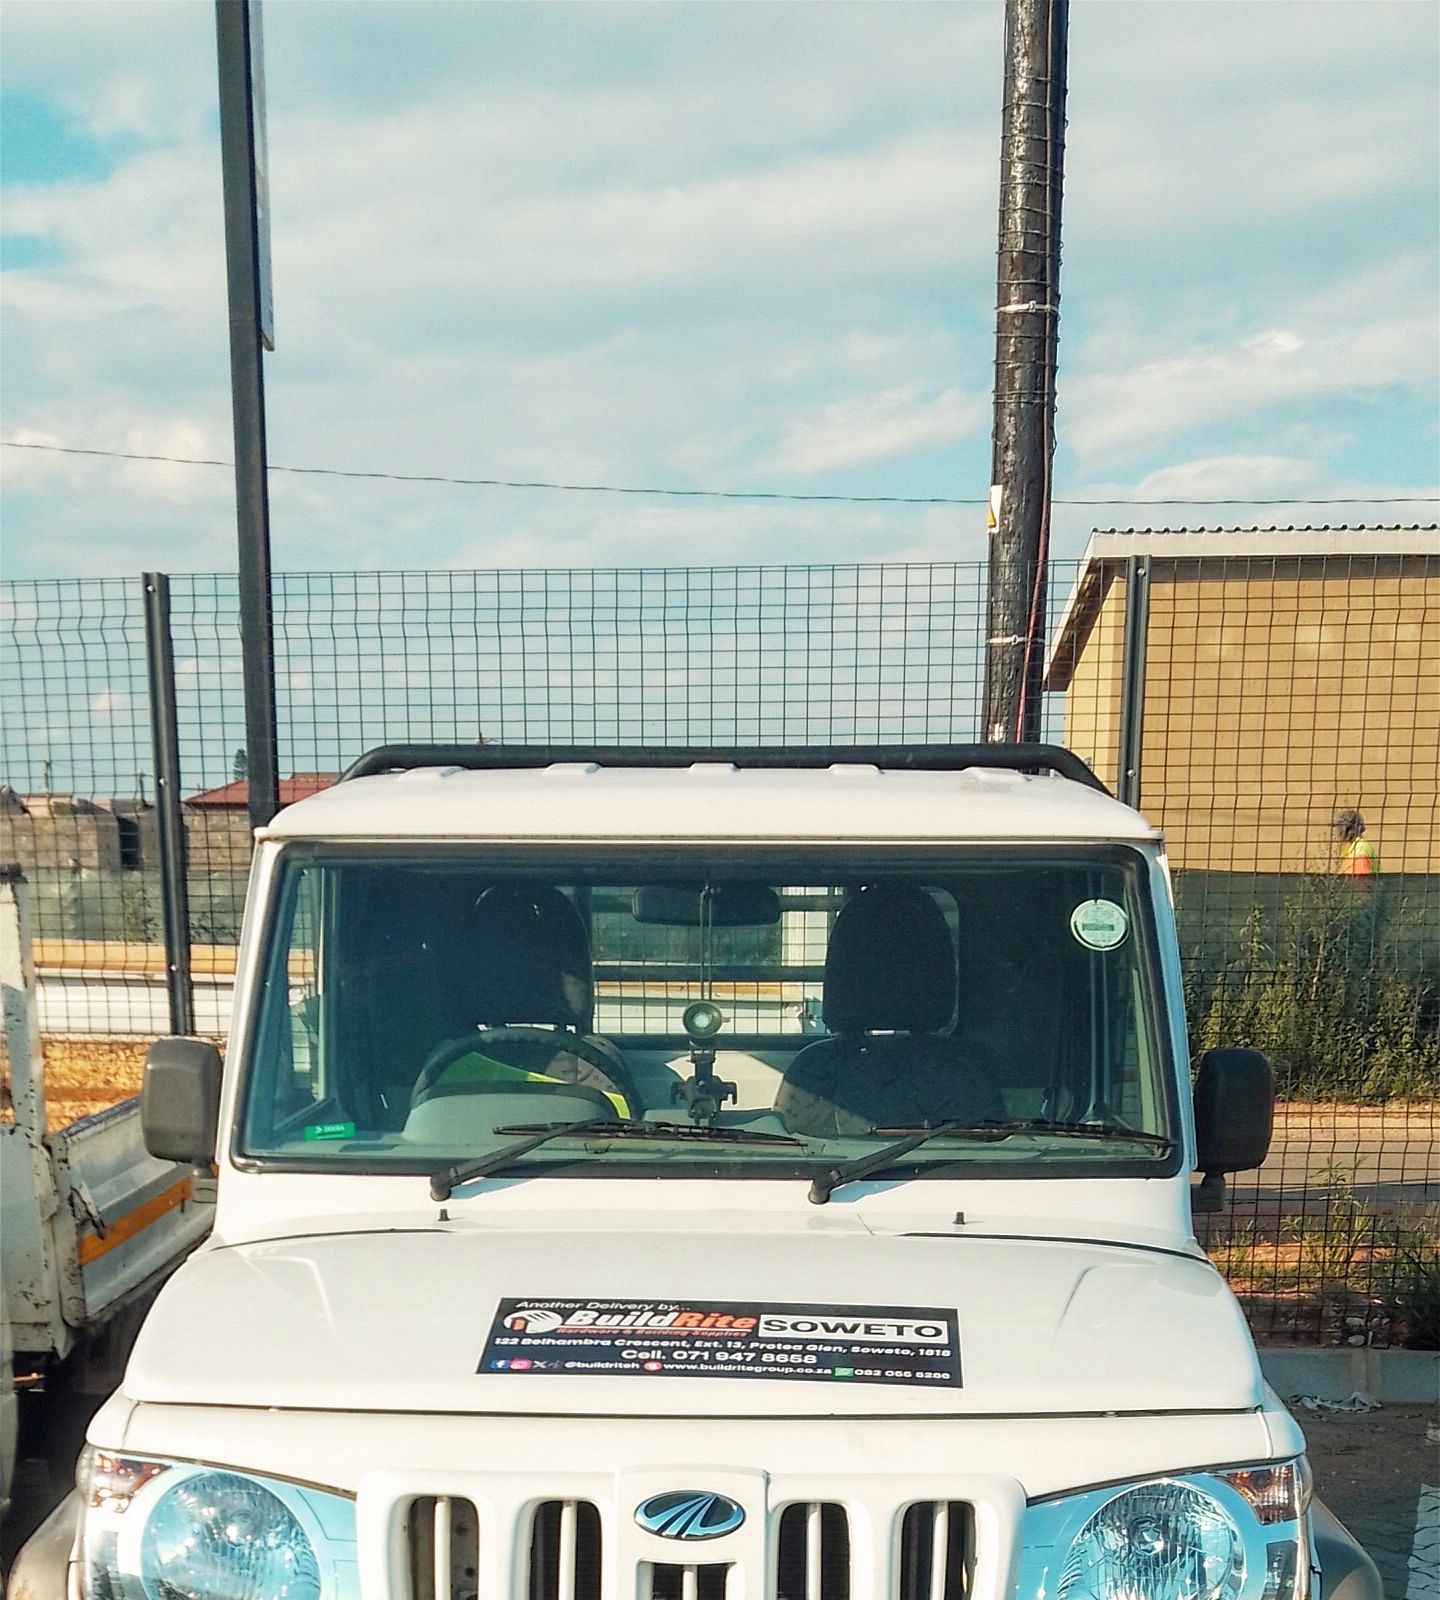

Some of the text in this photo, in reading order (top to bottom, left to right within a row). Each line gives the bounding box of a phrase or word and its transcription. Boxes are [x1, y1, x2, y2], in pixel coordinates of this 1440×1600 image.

[515, 1301, 584, 1309] Another
[586, 1302, 654, 1312] Delivery
[763, 1319, 943, 1338] SOWETO
[614, 1339, 691, 1348] Crescent,
[749, 1342, 803, 1351] Protea
[851, 1346, 916, 1356] Soweto,
[621, 1350, 817, 1364] Cell. 071 947 8658
[663, 1363, 832, 1374] www.buildritegroup.co.za
